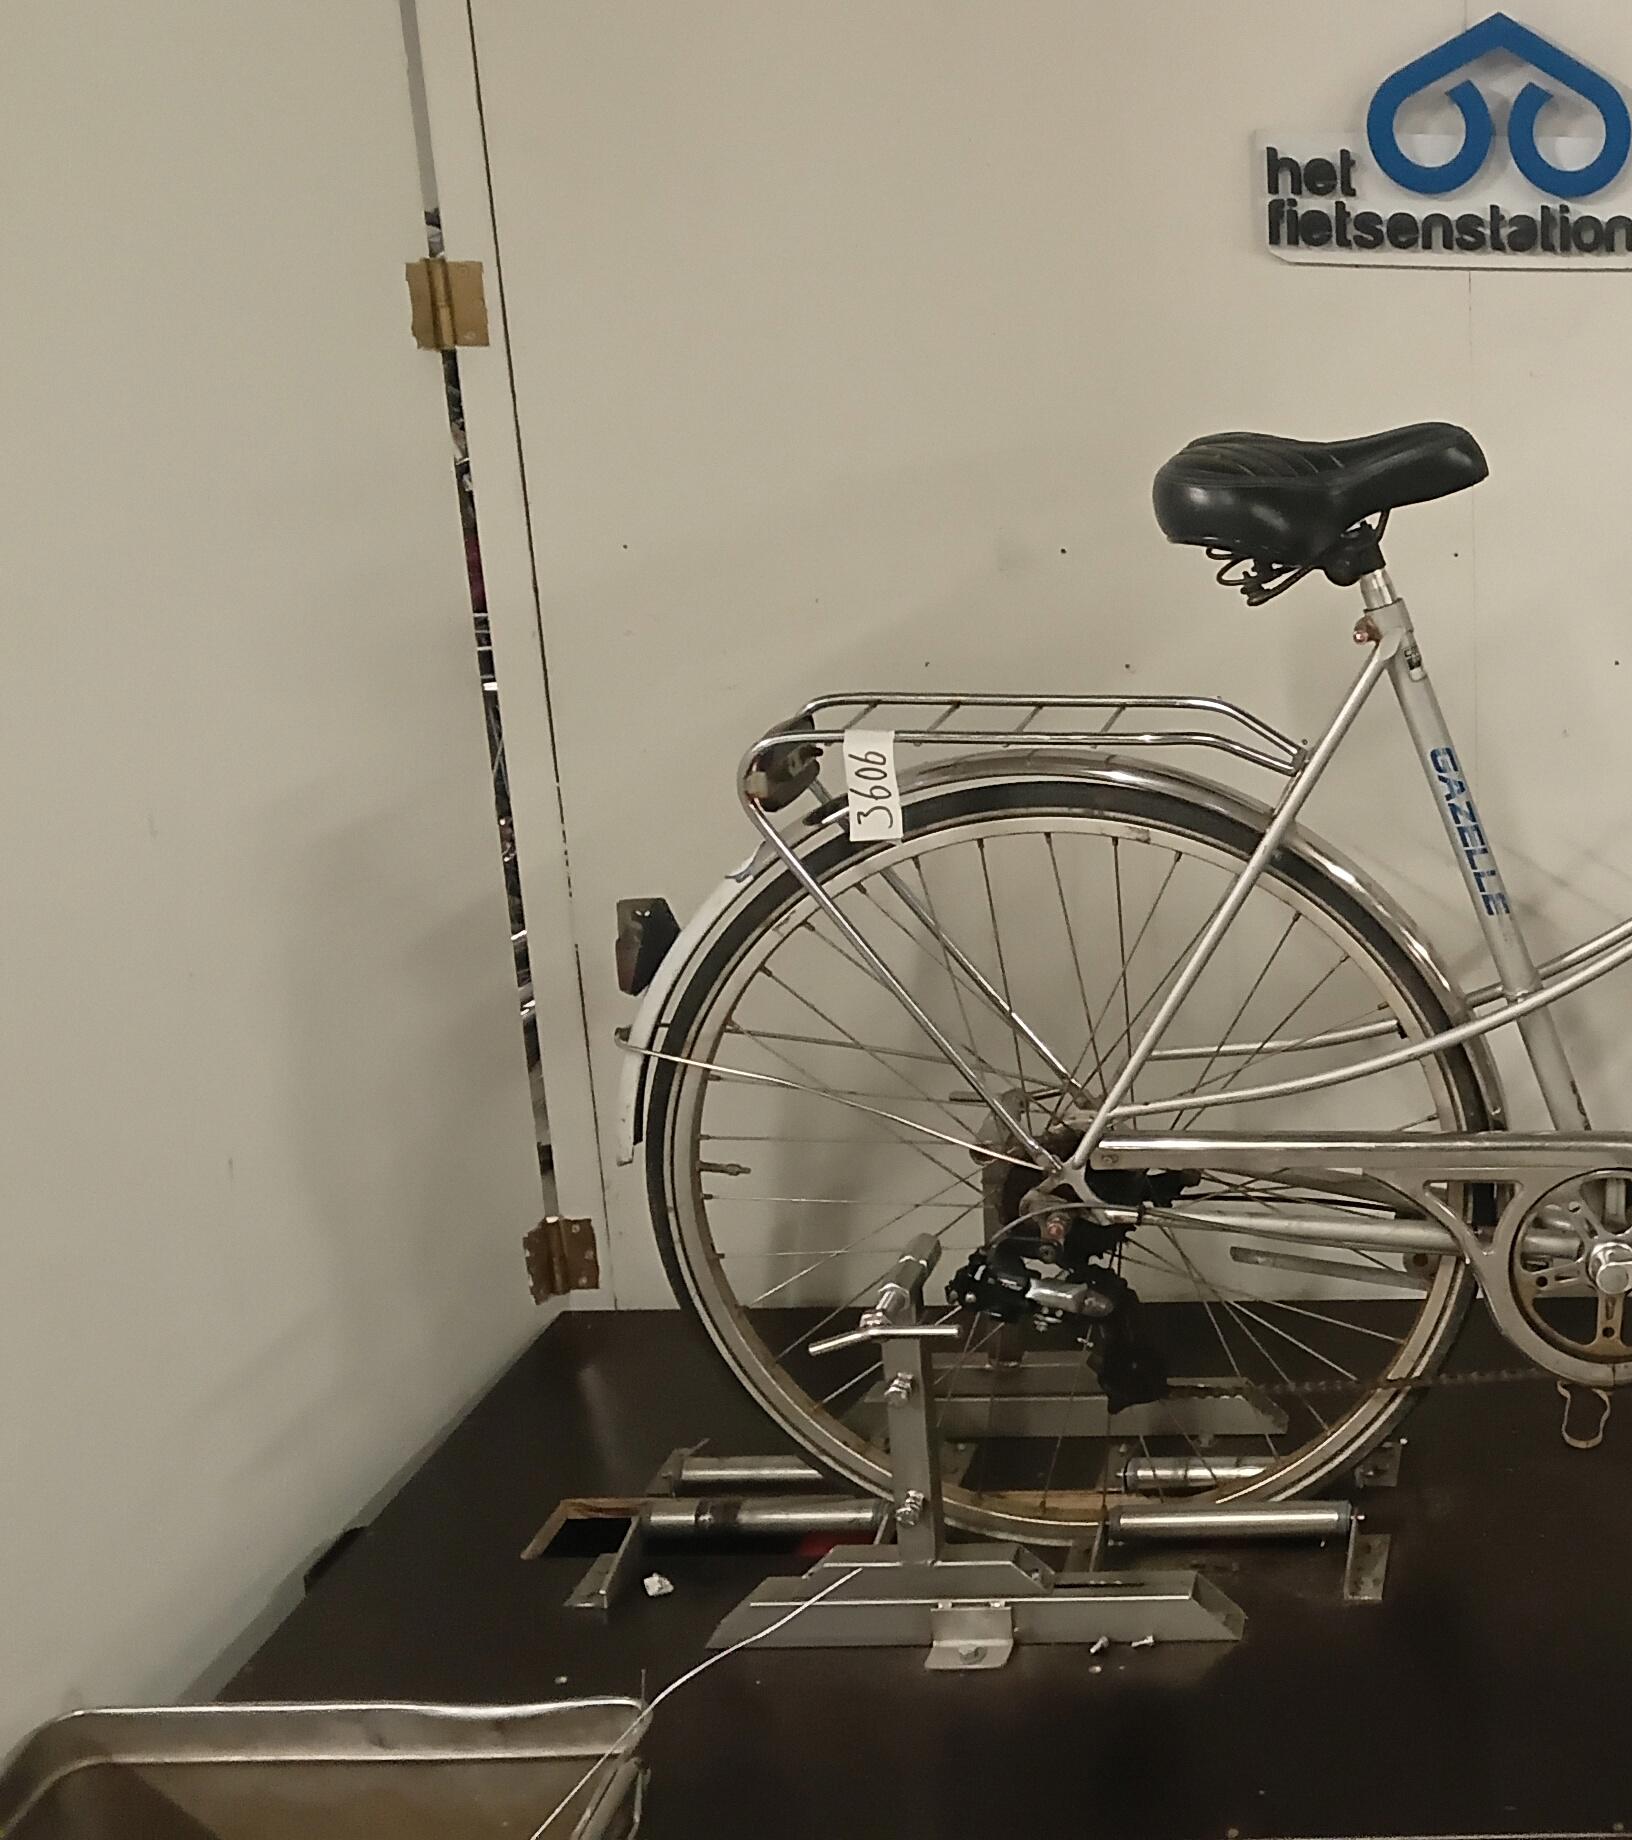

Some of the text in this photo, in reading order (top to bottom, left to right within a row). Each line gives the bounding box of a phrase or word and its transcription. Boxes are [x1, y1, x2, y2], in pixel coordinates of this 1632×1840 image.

[1266, 146, 1357, 197] het
[848, 751, 893, 829] 3606
[1430, 747, 1511, 916] GAZELLE
